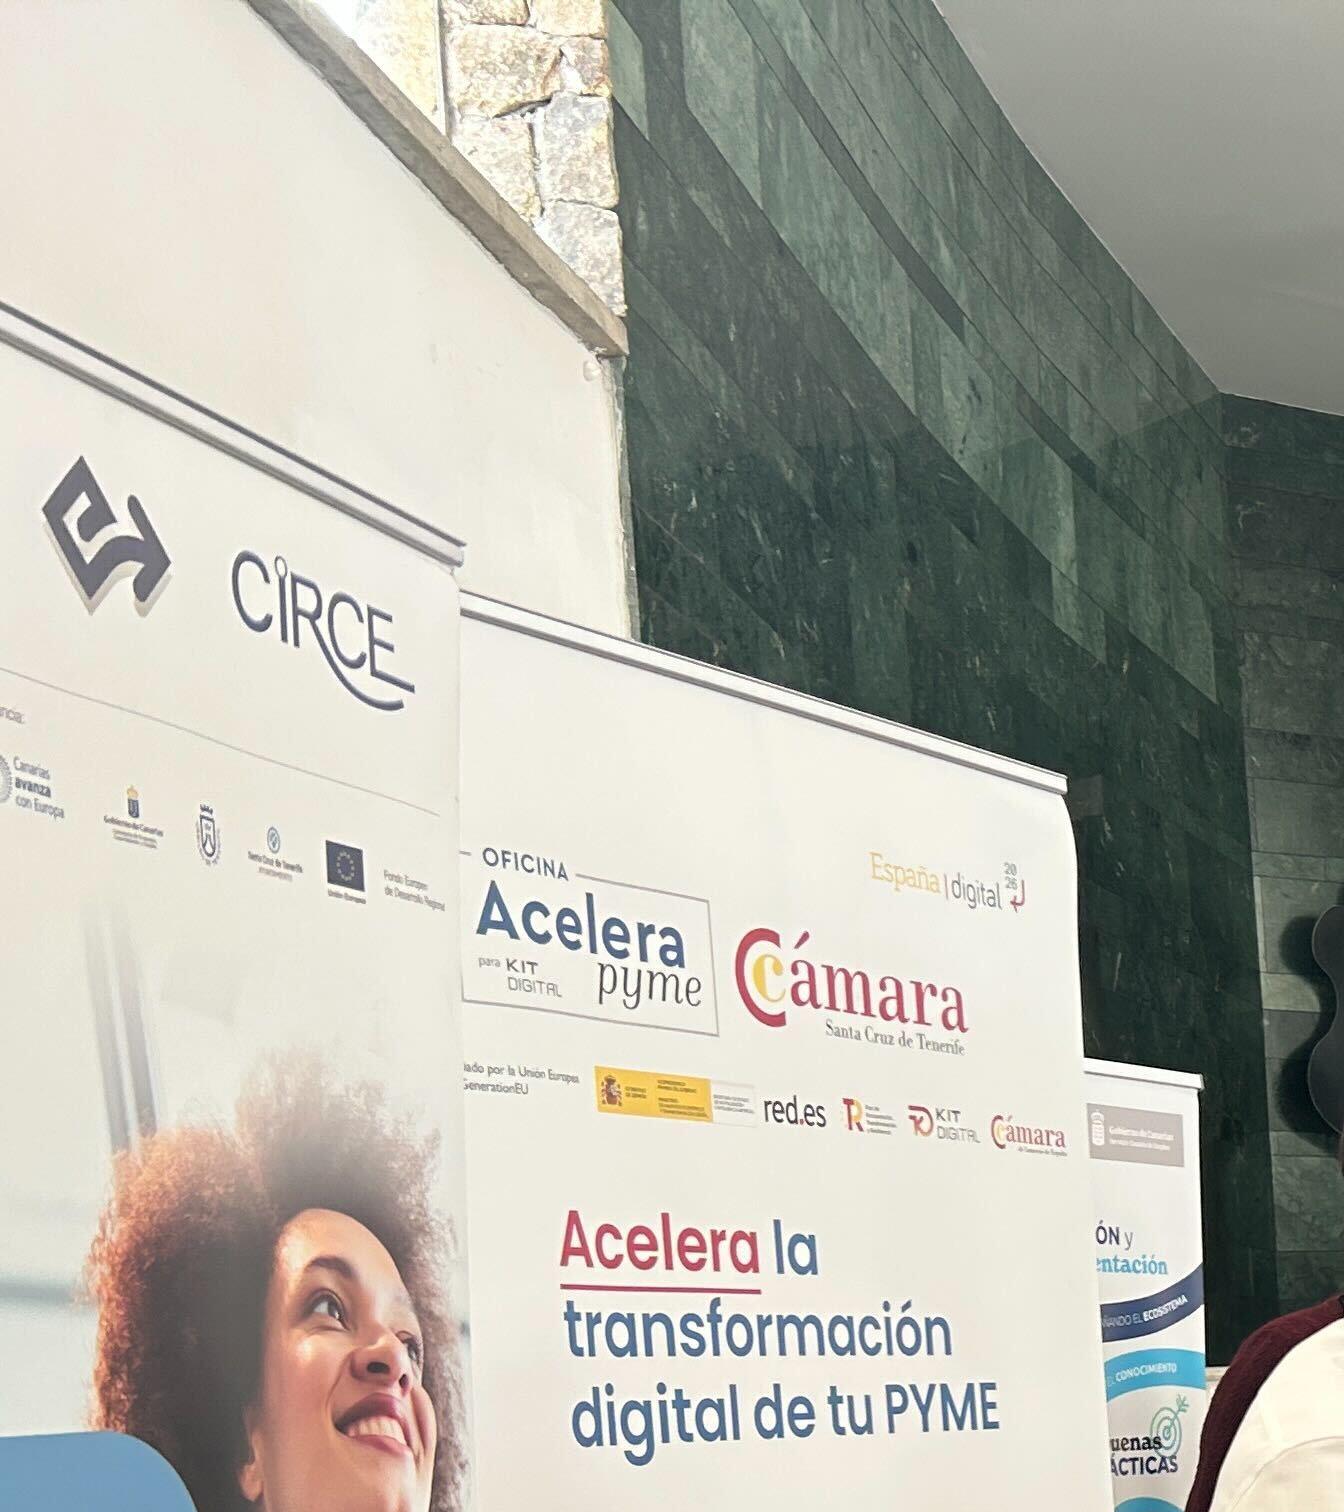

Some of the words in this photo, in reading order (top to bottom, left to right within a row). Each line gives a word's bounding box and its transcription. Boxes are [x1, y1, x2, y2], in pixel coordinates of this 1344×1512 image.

[232, 550, 415, 711] CIRCE
[14, 777, 51, 798] avanza
[16, 796, 32, 808] con
[33, 798, 65, 820] Europa
[482, 847, 569, 881] OFICINA
[869, 851, 942, 894] España
[951, 873, 1002, 910] digital
[476, 880, 685, 968] Acelera
[478, 957, 501, 968] para
[505, 958, 539, 975] KIT
[734, 927, 969, 1034] Cámara
[507, 977, 562, 998] DIGITAL
[597, 962, 701, 1010] pyme
[825, 1019, 861, 1042] Santa
[864, 1026, 895, 1047] Cruz
[898, 1032, 914, 1049] de
[916, 1033, 966, 1057] Tenerife
[487, 1064, 505, 1078] por
[507, 1064, 516, 1077] la
[518, 1066, 546, 1080] Unión
[763, 1094, 827, 1128] red.es
[935, 1107, 961, 1123] KIT
[991, 1113, 1066, 1150] Cámara
[937, 1125, 981, 1144] DIGITAL
[560, 1209, 760, 1275] Acelera
[773, 1218, 819, 1276] la
[1124, 1231, 1133, 1250] y
[563, 1296, 952, 1358] transformación
[1115, 1362, 1177, 1382] CONOCIMIENTO
[572, 1382, 741, 1466] digital
[754, 1383, 816, 1439] de
[827, 1384, 874, 1436] tu
[884, 1382, 1000, 1434] PYME
